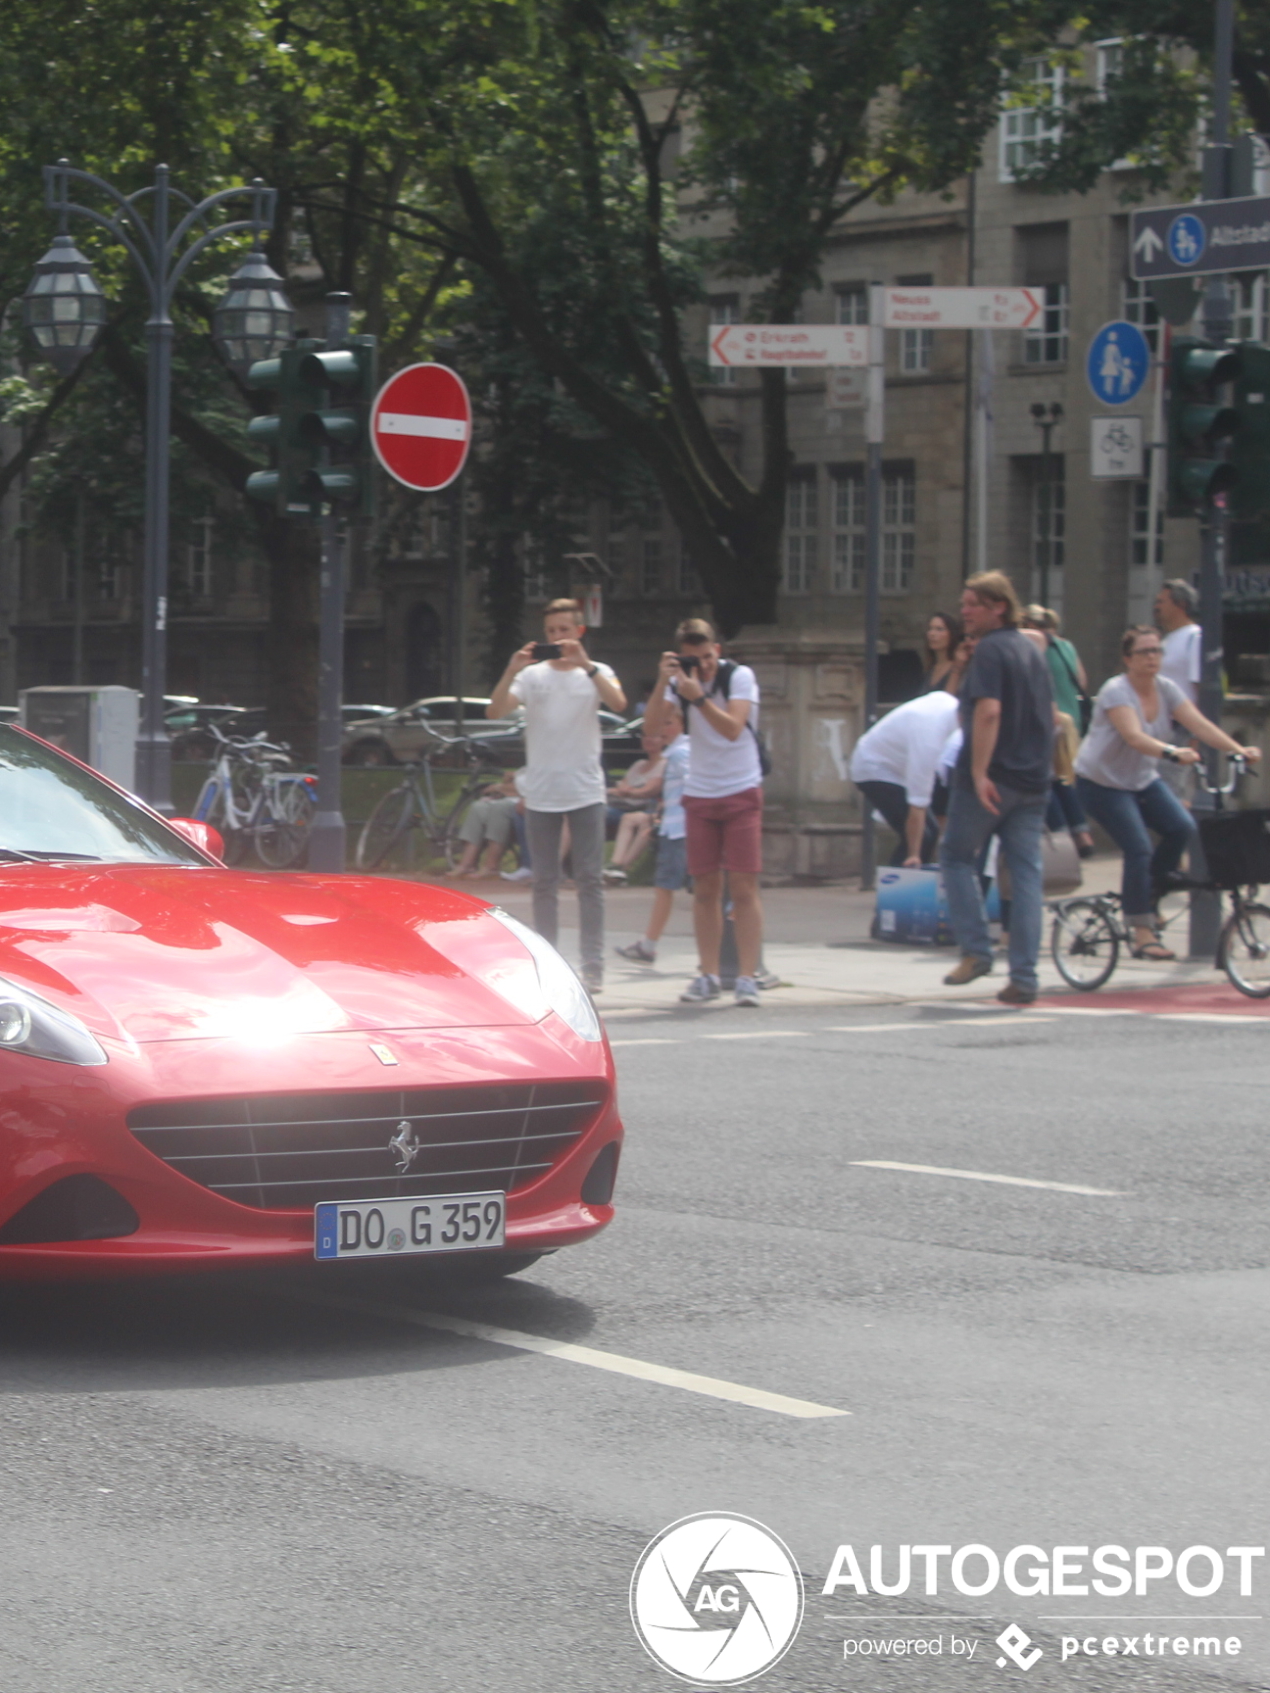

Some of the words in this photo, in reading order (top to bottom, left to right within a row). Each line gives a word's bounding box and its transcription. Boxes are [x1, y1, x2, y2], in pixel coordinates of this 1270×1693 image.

[323, 1237, 332, 1249] D
[340, 1208, 385, 1250] DO
[411, 1205, 432, 1246] G
[441, 1200, 502, 1243] 359
